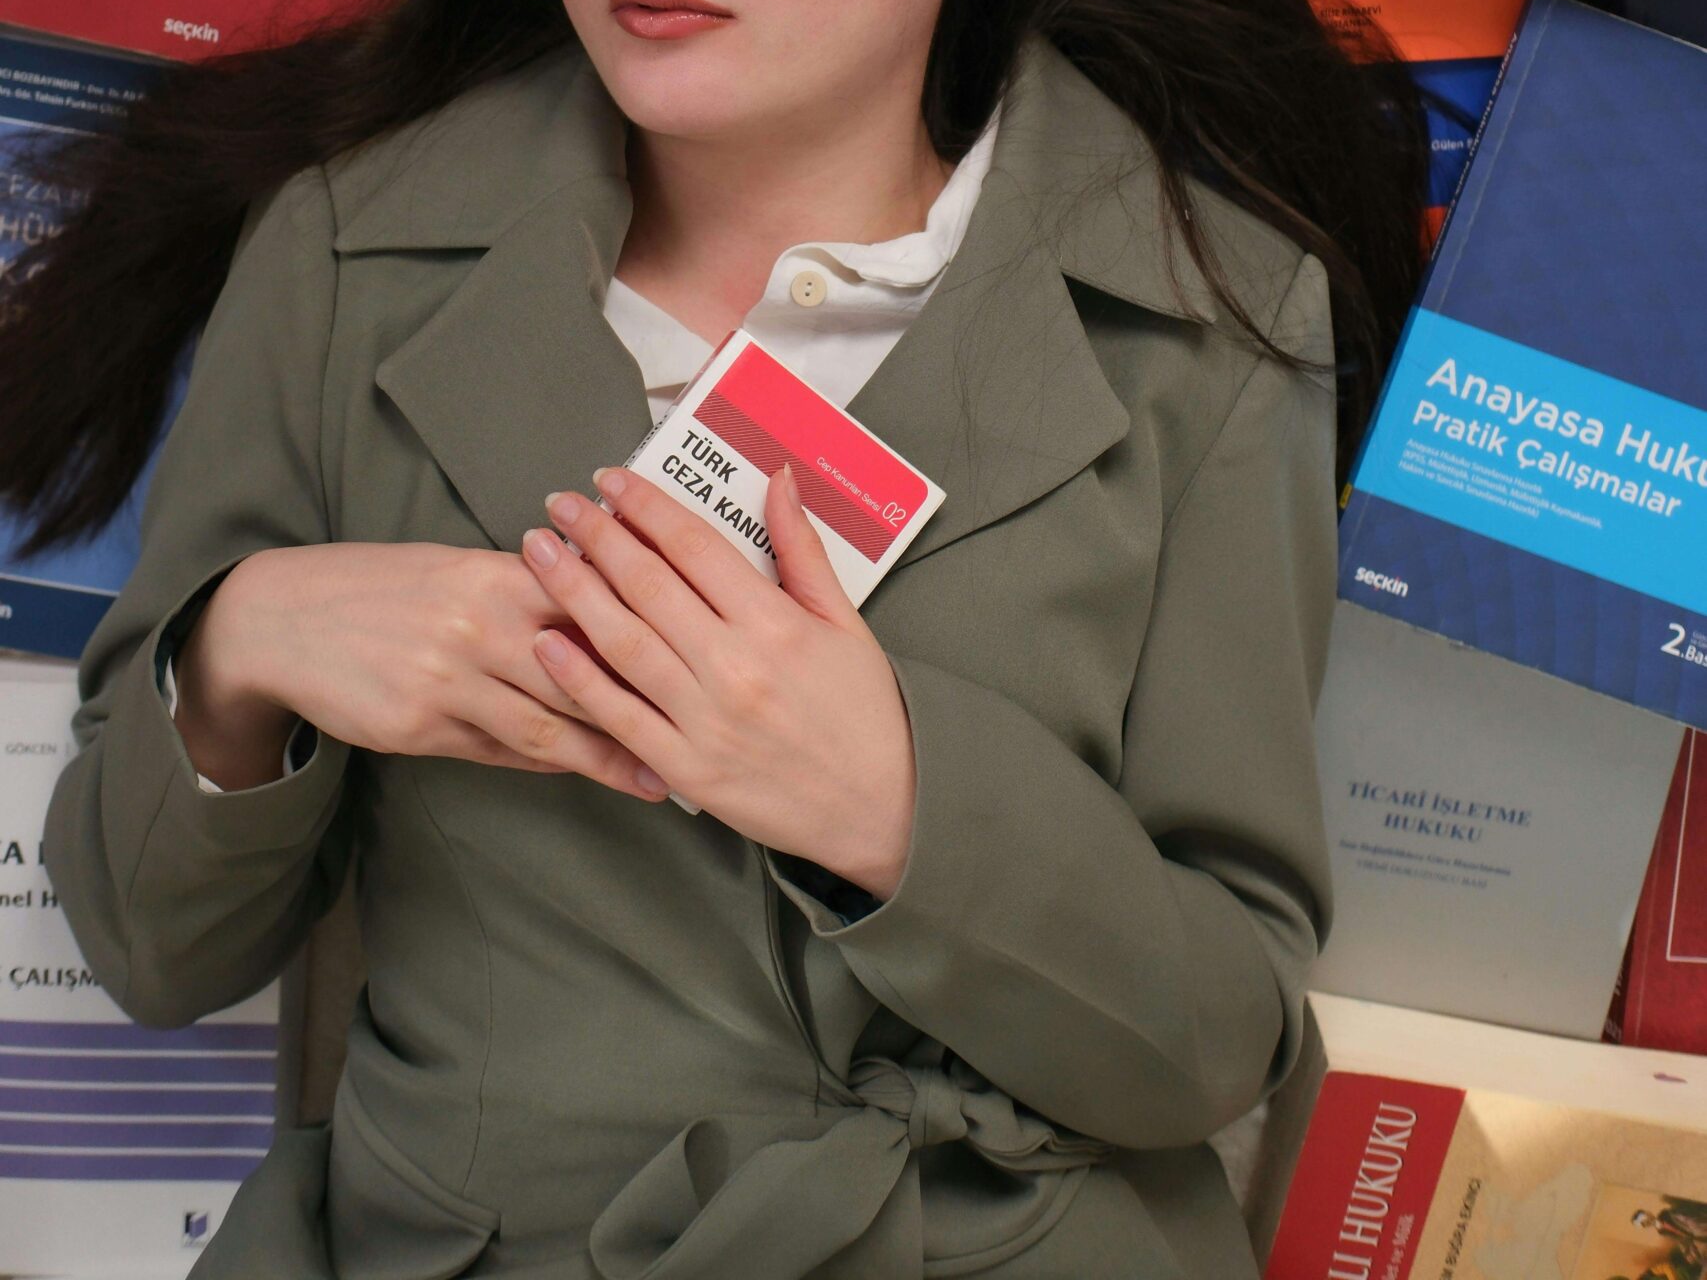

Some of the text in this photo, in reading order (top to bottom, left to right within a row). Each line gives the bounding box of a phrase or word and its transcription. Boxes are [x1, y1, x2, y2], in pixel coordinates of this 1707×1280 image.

[1425, 357, 1605, 448] Anayasa
[661, 454, 714, 505] CEZA
[682, 430, 738, 484] TÜRK
[816, 457, 832, 473] Cep
[860, 492, 881, 512] Serisi
[1412, 399, 1508, 457] Pratik
[1516, 438, 1682, 517] Çalışmalar
[882, 501, 906, 528] 02
[1340, 1102, 1418, 1247] HUKUKU
